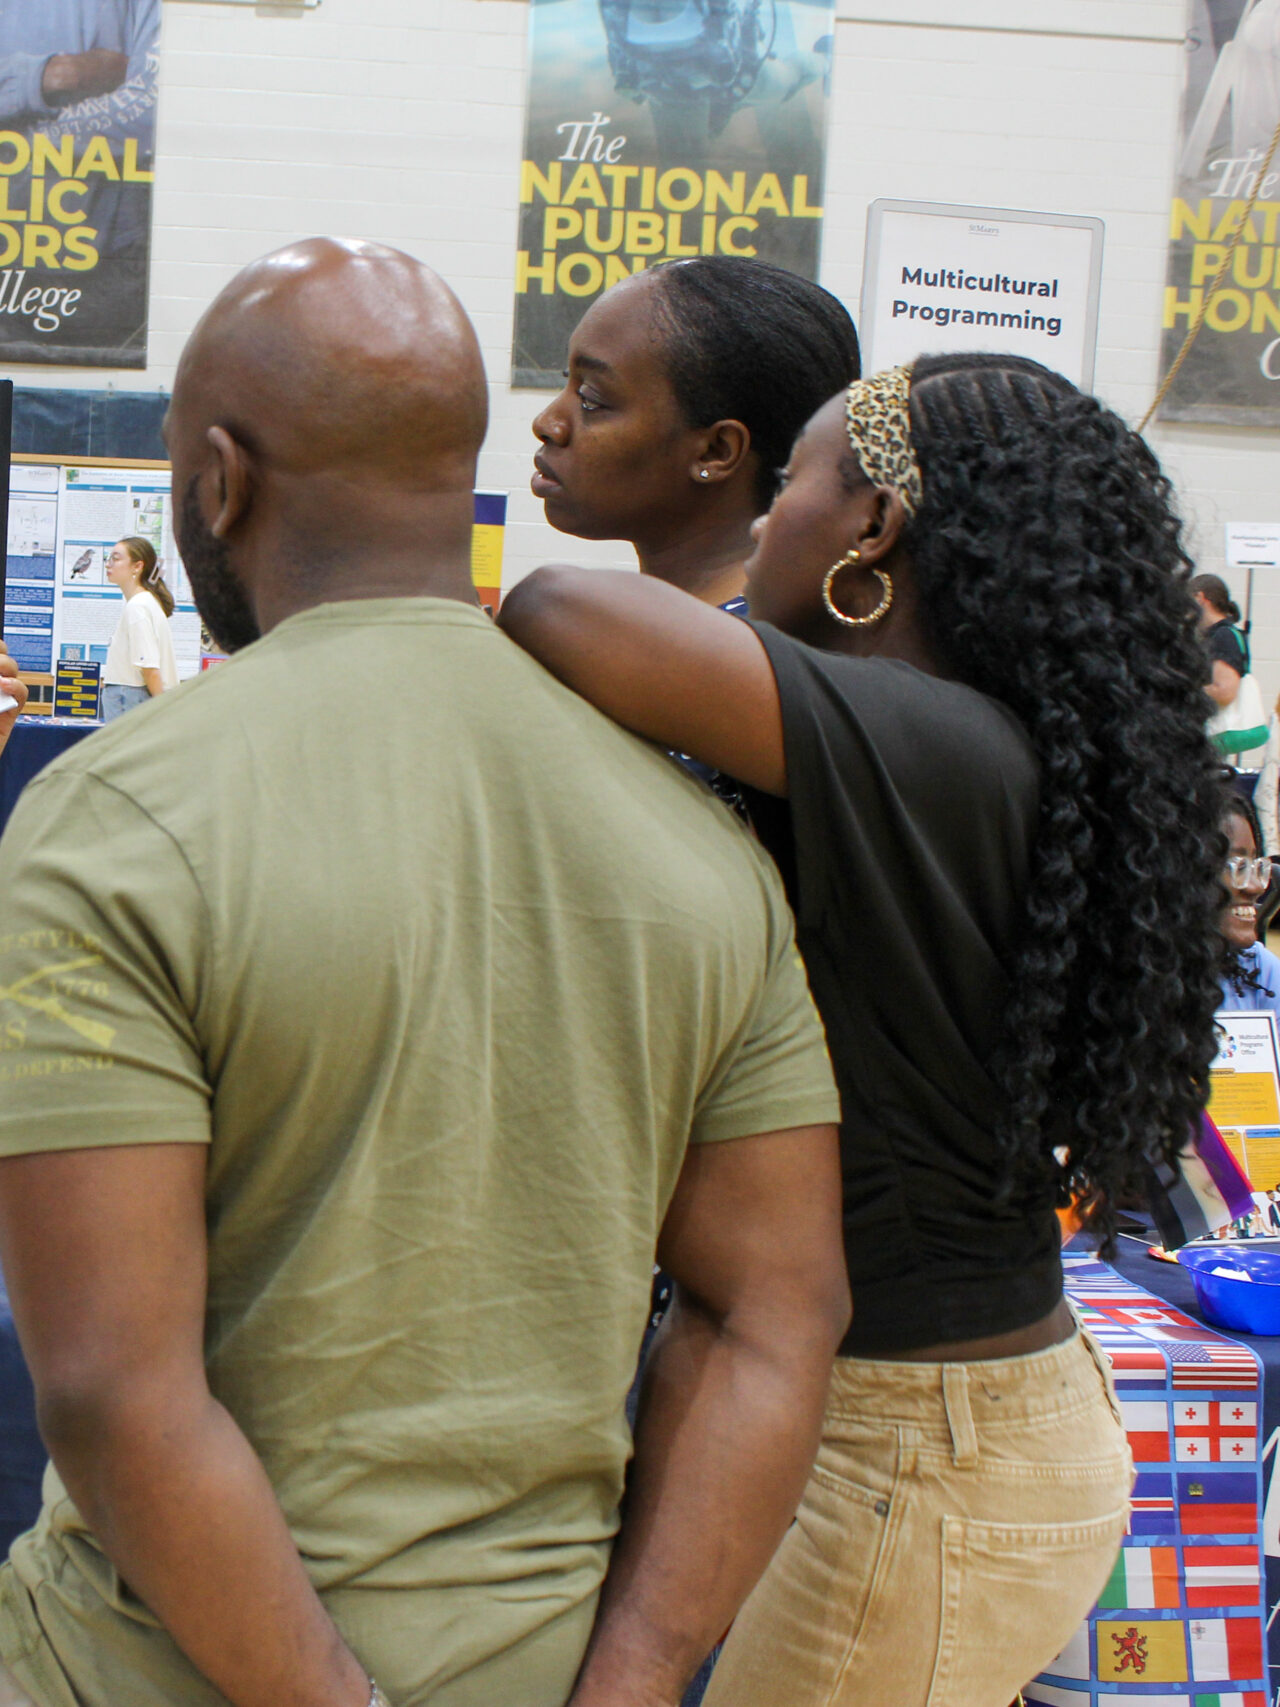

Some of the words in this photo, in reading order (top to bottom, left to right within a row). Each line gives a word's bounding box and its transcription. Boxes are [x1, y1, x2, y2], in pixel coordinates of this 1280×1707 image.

[556, 111, 627, 164] The
[520, 159, 825, 219] NATIONAL
[1208, 148, 1279, 200] The
[543, 206, 760, 258] PUBLIC
[514, 250, 675, 297] HON
[901, 265, 1059, 298] Multicultural
[1191, 242, 1280, 290] PU
[891, 299, 1063, 337] Programming
